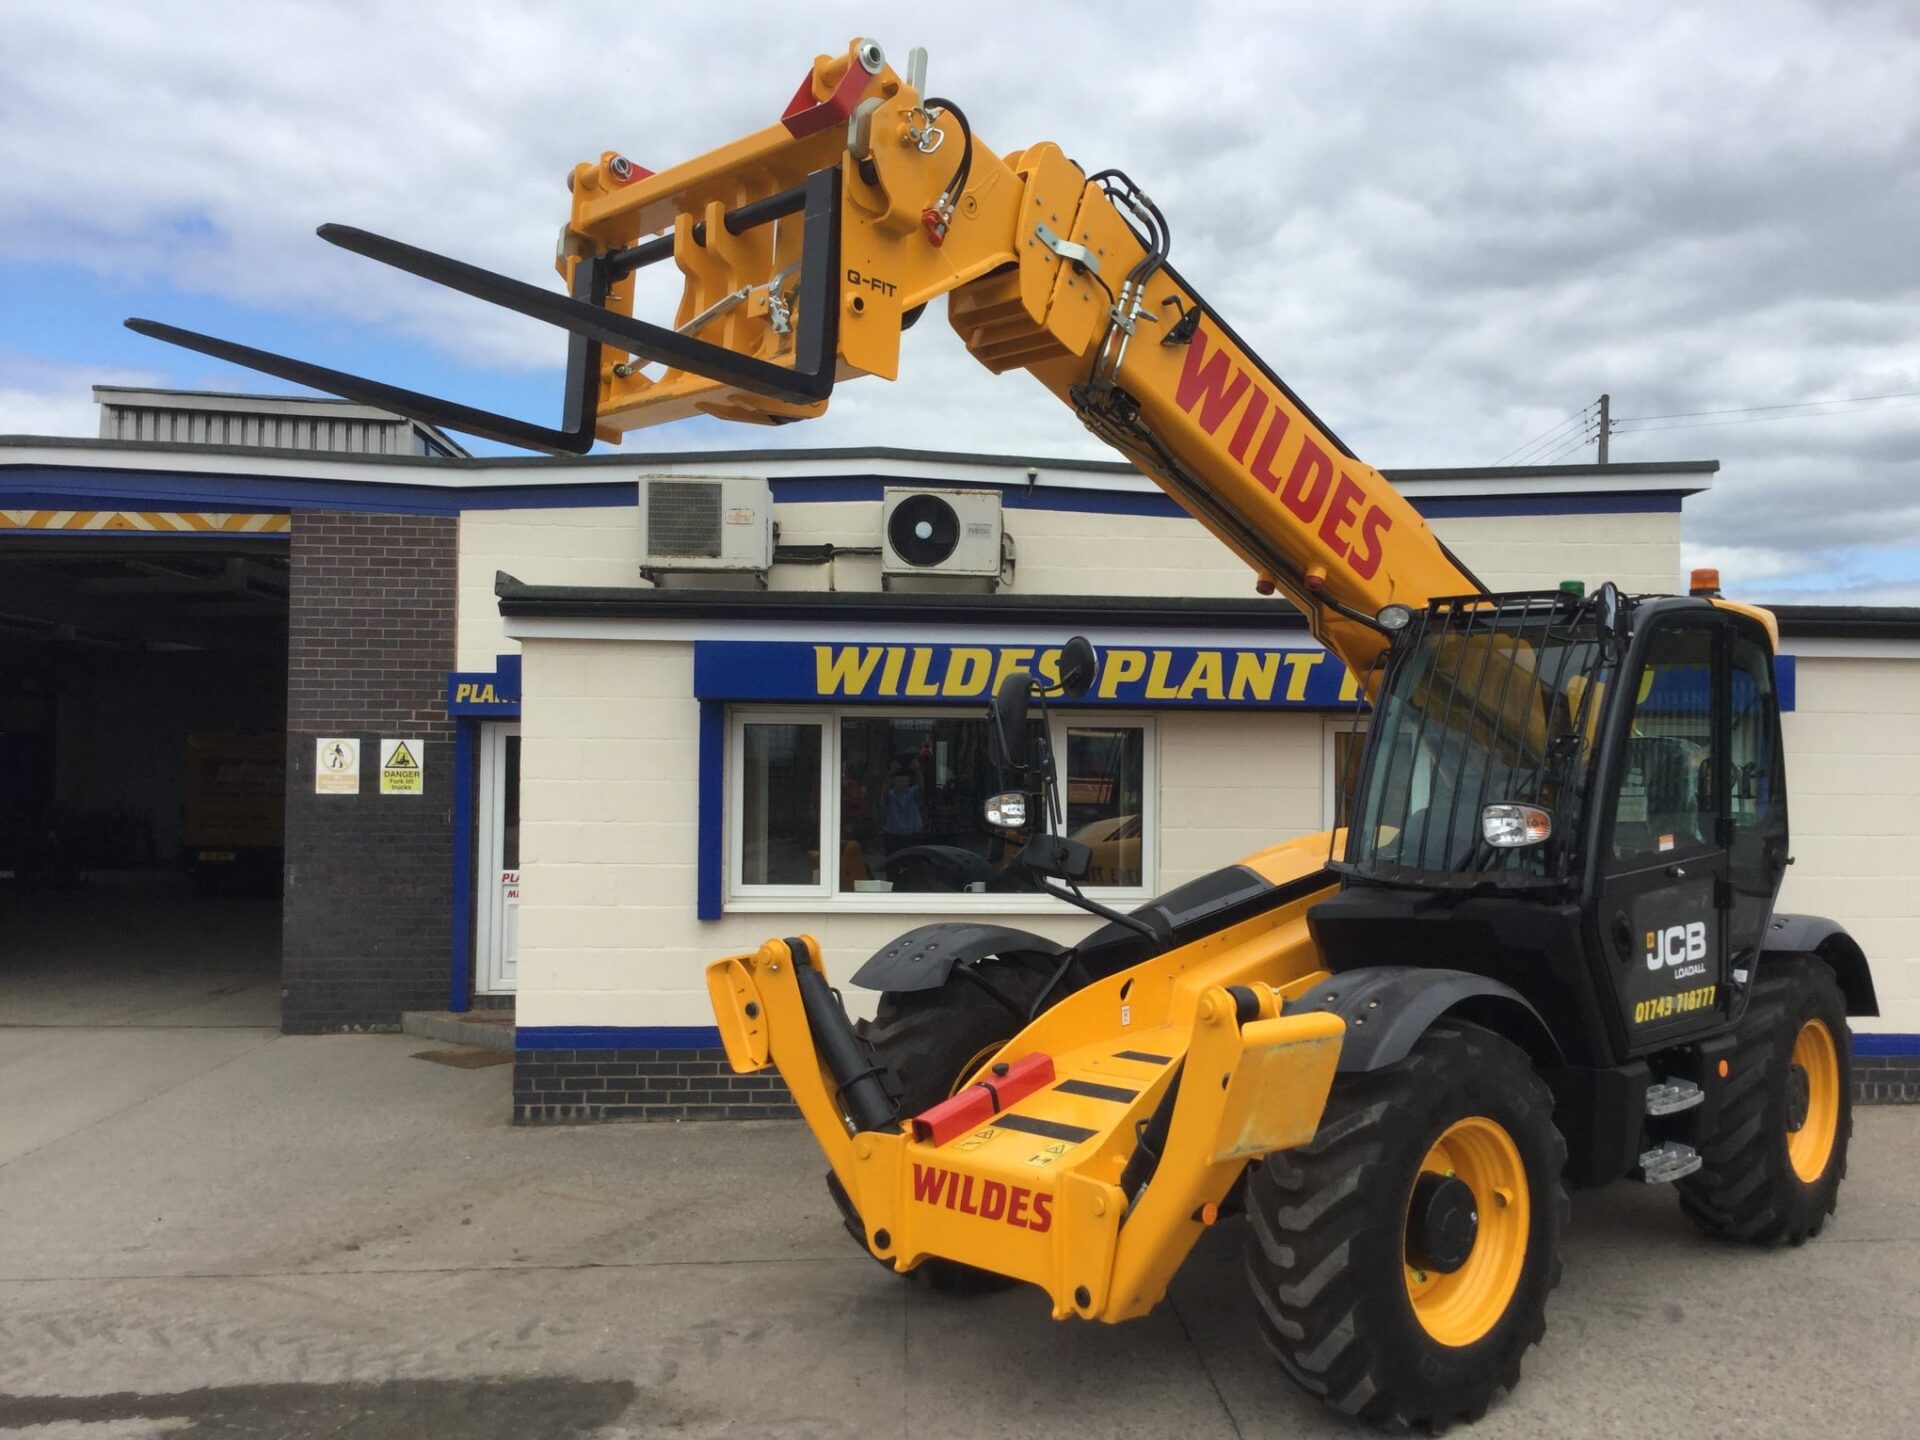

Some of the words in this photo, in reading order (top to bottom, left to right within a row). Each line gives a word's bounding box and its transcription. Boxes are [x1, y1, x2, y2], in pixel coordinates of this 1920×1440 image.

[847, 269, 897, 297] Q-FIT
[1175, 326, 1393, 581] WILDES
[813, 646, 1066, 697] WILDES
[1098, 650, 1325, 701] PLANT
[455, 683, 519, 704] PLA
[384, 770, 420, 778] DANGER
[1646, 922, 1706, 970] JCB
[1674, 963, 1706, 979] LOADALL
[1635, 996, 1673, 1023] 01743
[1677, 985, 1716, 1013] 718777
[913, 1163, 1053, 1233] WILDES
